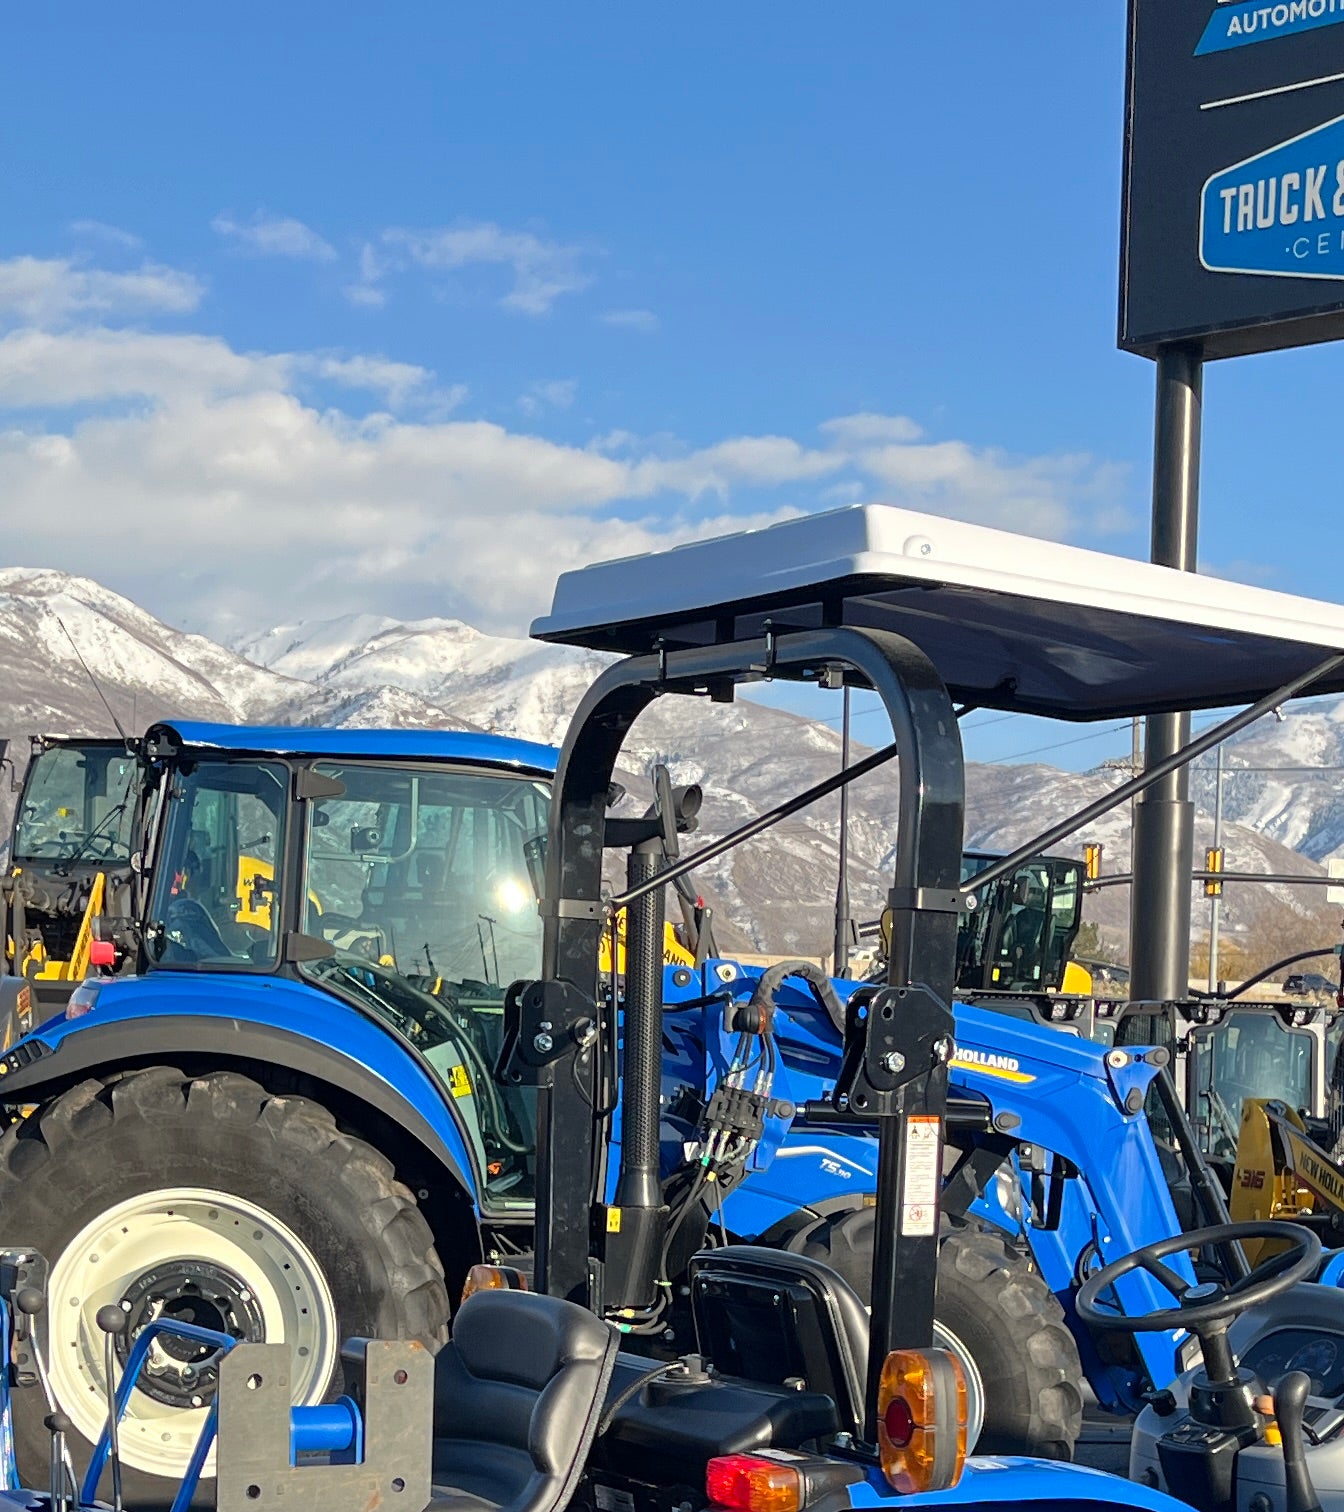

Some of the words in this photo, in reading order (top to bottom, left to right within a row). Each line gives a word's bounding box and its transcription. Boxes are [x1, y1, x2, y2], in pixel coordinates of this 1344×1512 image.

[1219, 166, 1325, 234] TRUCK
[955, 1046, 1019, 1071] HOLLAND
[1300, 1151, 1320, 1179] NEW
